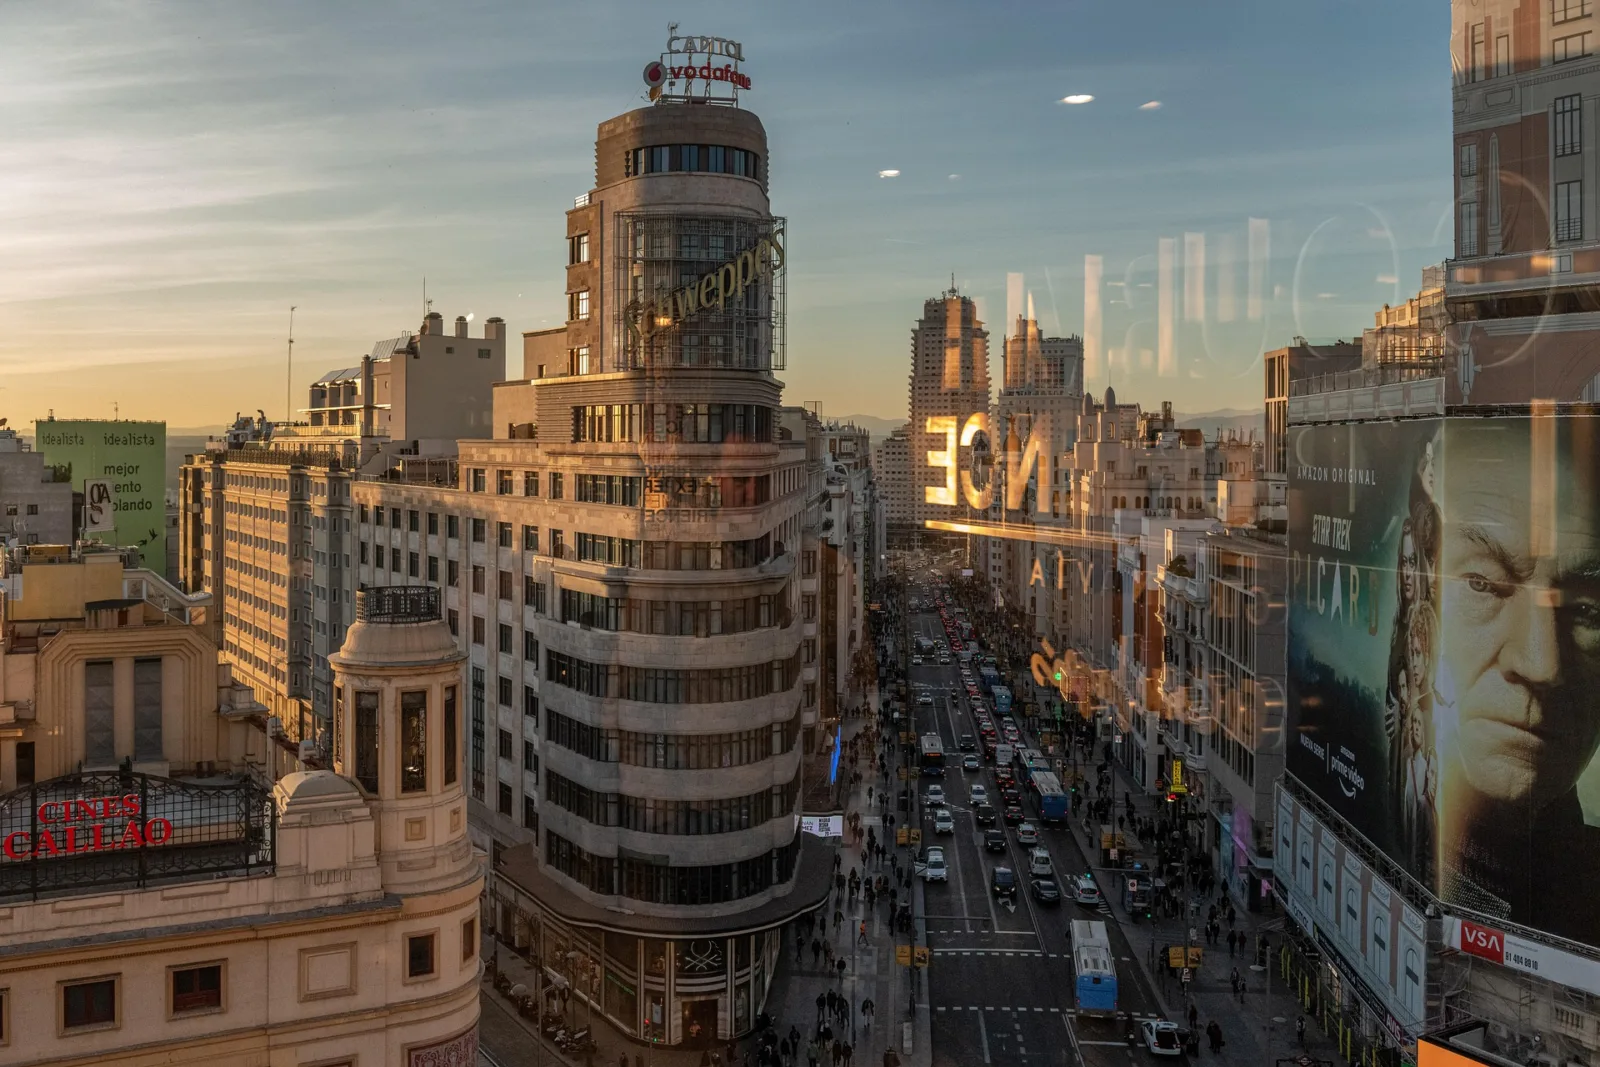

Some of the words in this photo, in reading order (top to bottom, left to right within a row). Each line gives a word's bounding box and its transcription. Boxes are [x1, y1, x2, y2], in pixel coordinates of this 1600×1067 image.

[667, 36, 745, 61] CAPITOL
[670, 62, 752, 90] vodafone
[624, 228, 785, 350] Schweppes
[42, 433, 84, 445] idealista
[104, 433, 155, 446] idealista
[104, 462, 140, 478] mejor
[1297, 466, 1328, 482] AMAZON
[1332, 467, 1376, 486] ORIGINAL
[113, 481, 142, 493] ento
[1312, 514, 1331, 547] STAR
[1332, 516, 1352, 552] TREK
[1331, 755, 1348, 778] prime
[1347, 766, 1364, 791] video
[38, 794, 141, 824] CINES
[3, 817, 173, 859] CALLAO
[1464, 927, 1500, 952] VSA
[1386, 1013, 1402, 1042] AVIS
